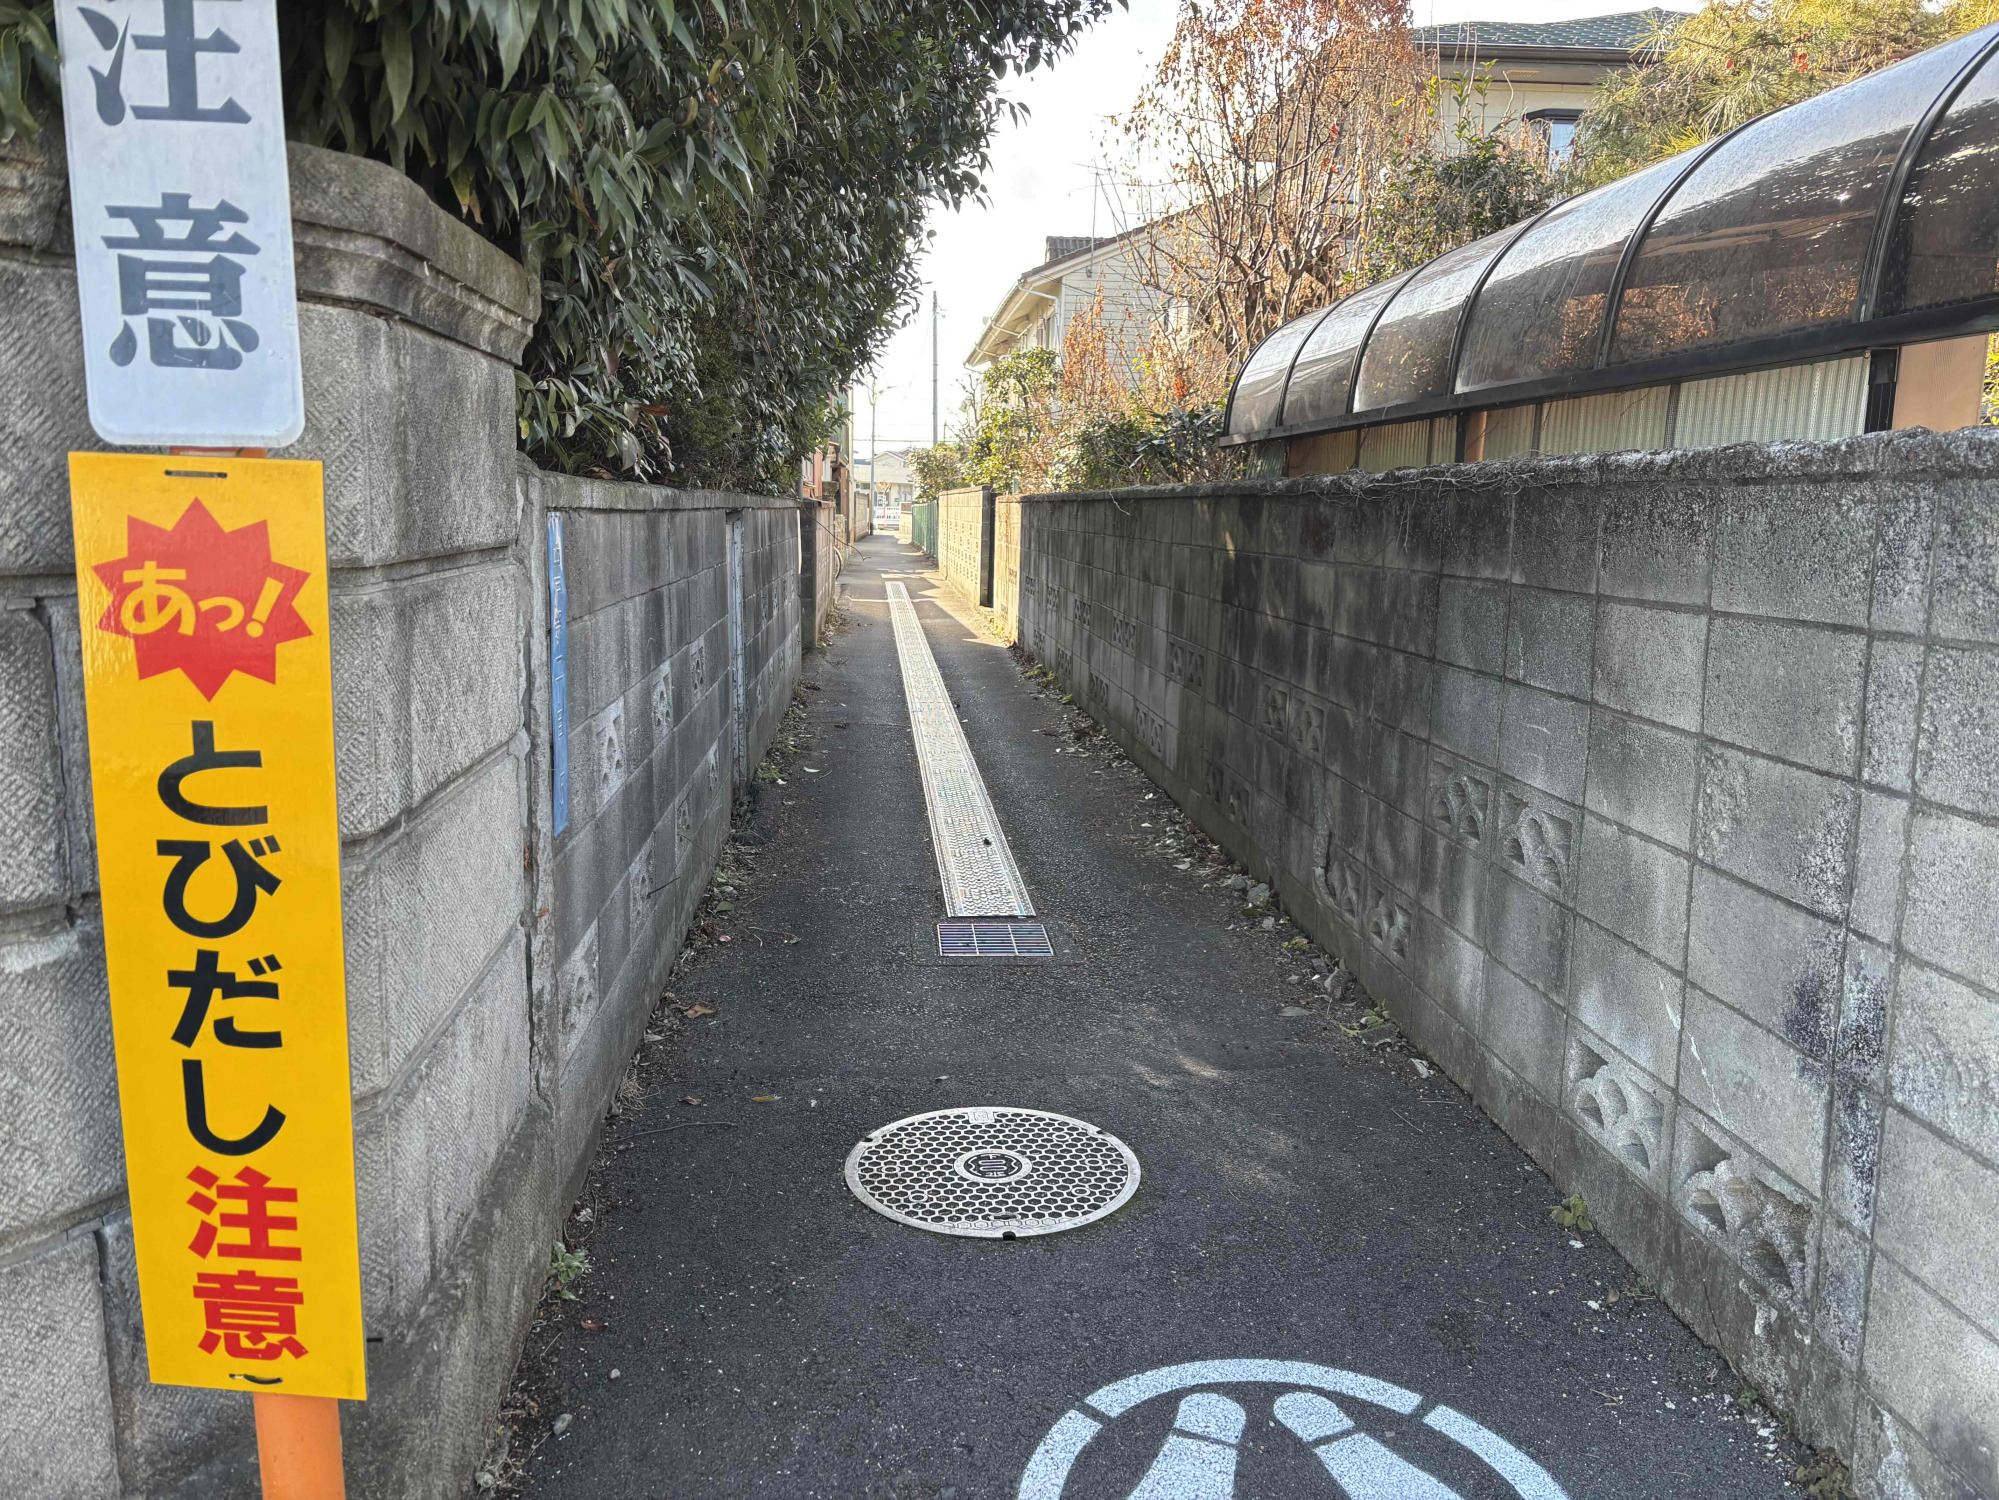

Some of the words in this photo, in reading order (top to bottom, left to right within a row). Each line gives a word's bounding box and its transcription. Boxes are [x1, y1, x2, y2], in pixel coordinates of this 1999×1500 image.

[76, 0, 261, 371] 注意
[120, 560, 284, 638] あっ!
[156, 719, 309, 1361] とびだし注意
